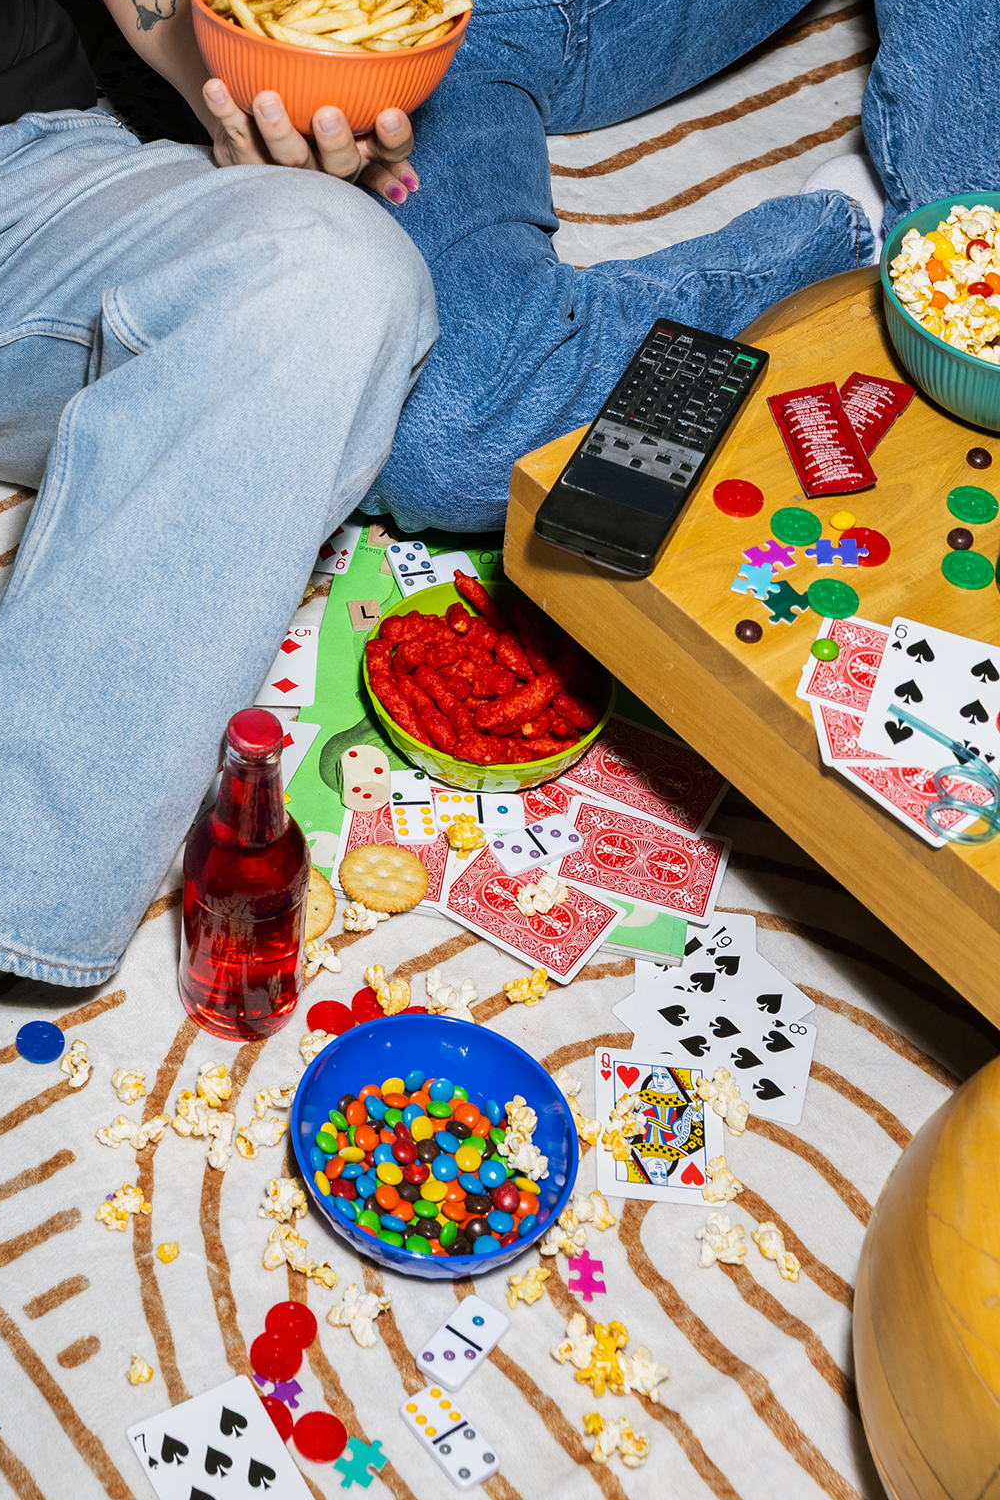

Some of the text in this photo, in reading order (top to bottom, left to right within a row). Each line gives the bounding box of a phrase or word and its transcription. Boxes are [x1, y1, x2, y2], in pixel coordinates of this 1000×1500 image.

[360, 605, 375, 619] L
[294, 628, 312, 638] 5
[894, 624, 909, 640] 6
[788, 1023, 808, 1036] 8
[600, 1052, 612, 1069] Q
[133, 1433, 147, 1454] 7
